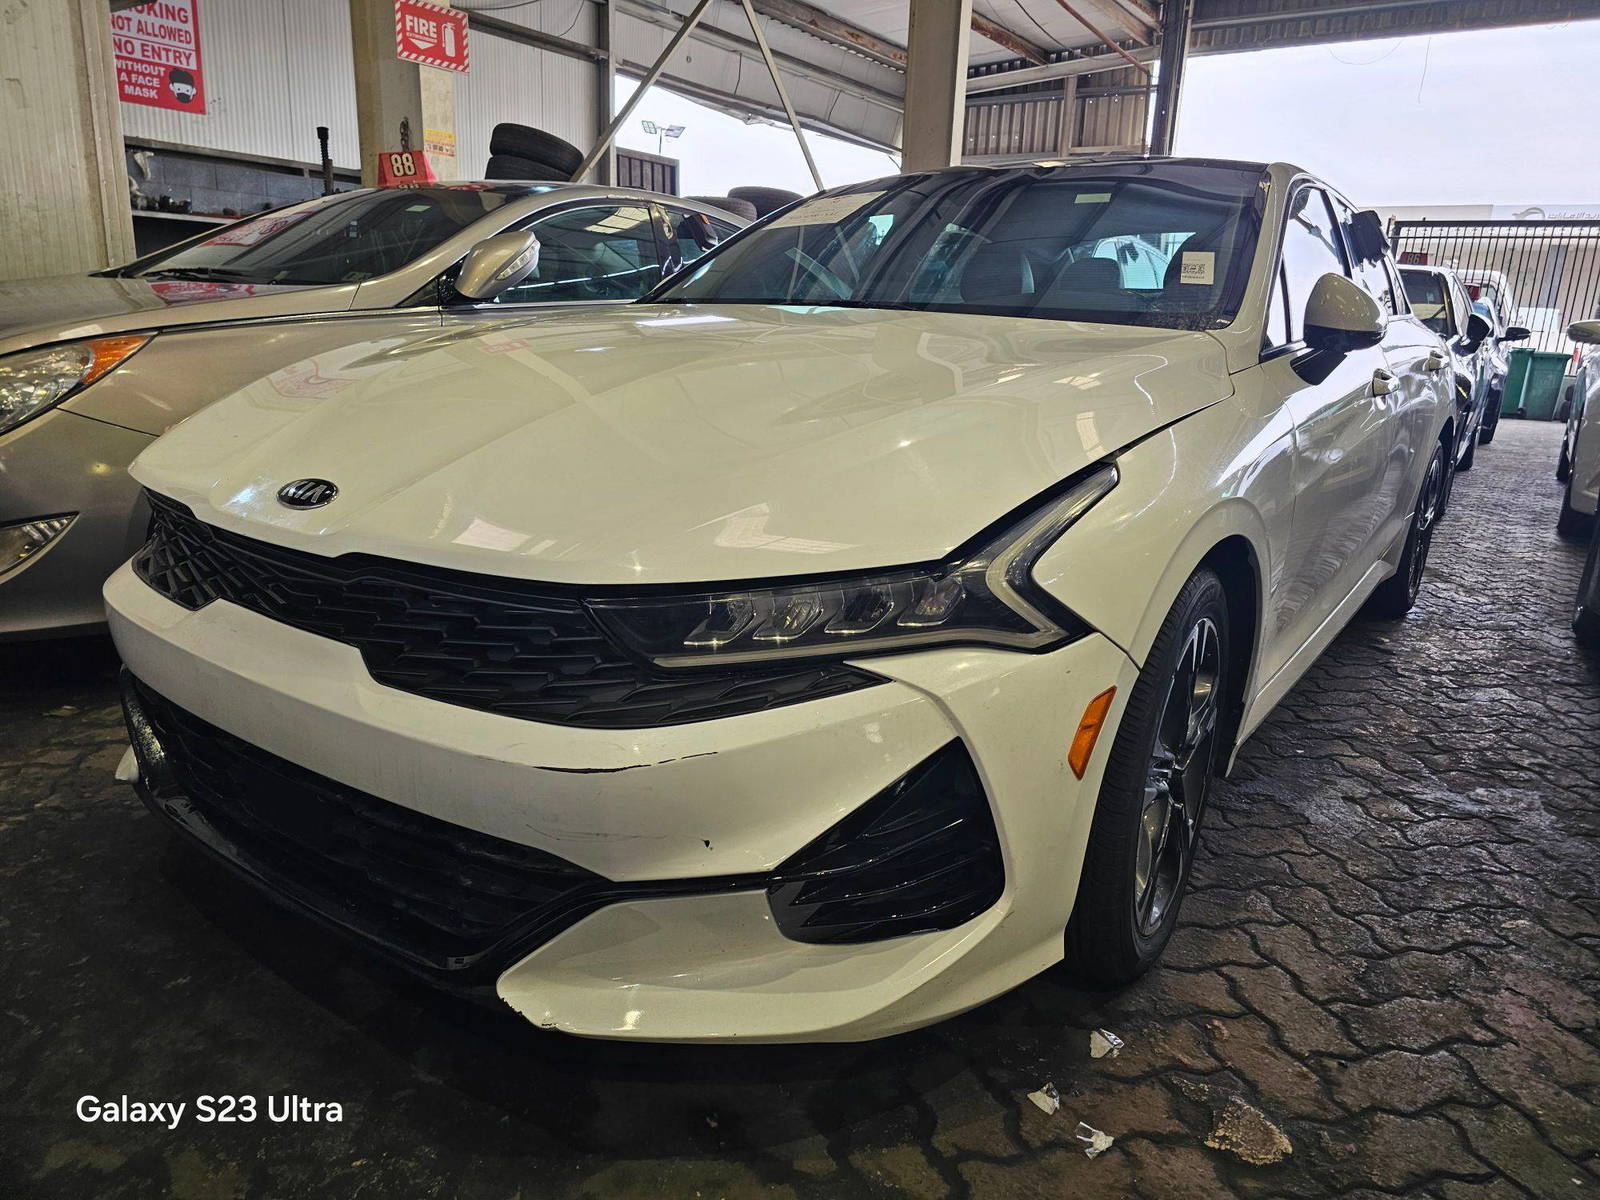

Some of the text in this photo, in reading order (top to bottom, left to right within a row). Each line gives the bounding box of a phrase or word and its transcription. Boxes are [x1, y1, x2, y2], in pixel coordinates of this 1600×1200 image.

[136, 20, 192, 45] ALLOWED
[405, 14, 437, 39] FIRE
[113, 37, 192, 67] NO ENTRY
[120, 72, 161, 88] A FACE
[124, 85, 158, 100] MASK
[390, 153, 415, 177] 88
[280, 480, 327, 503] KIA
